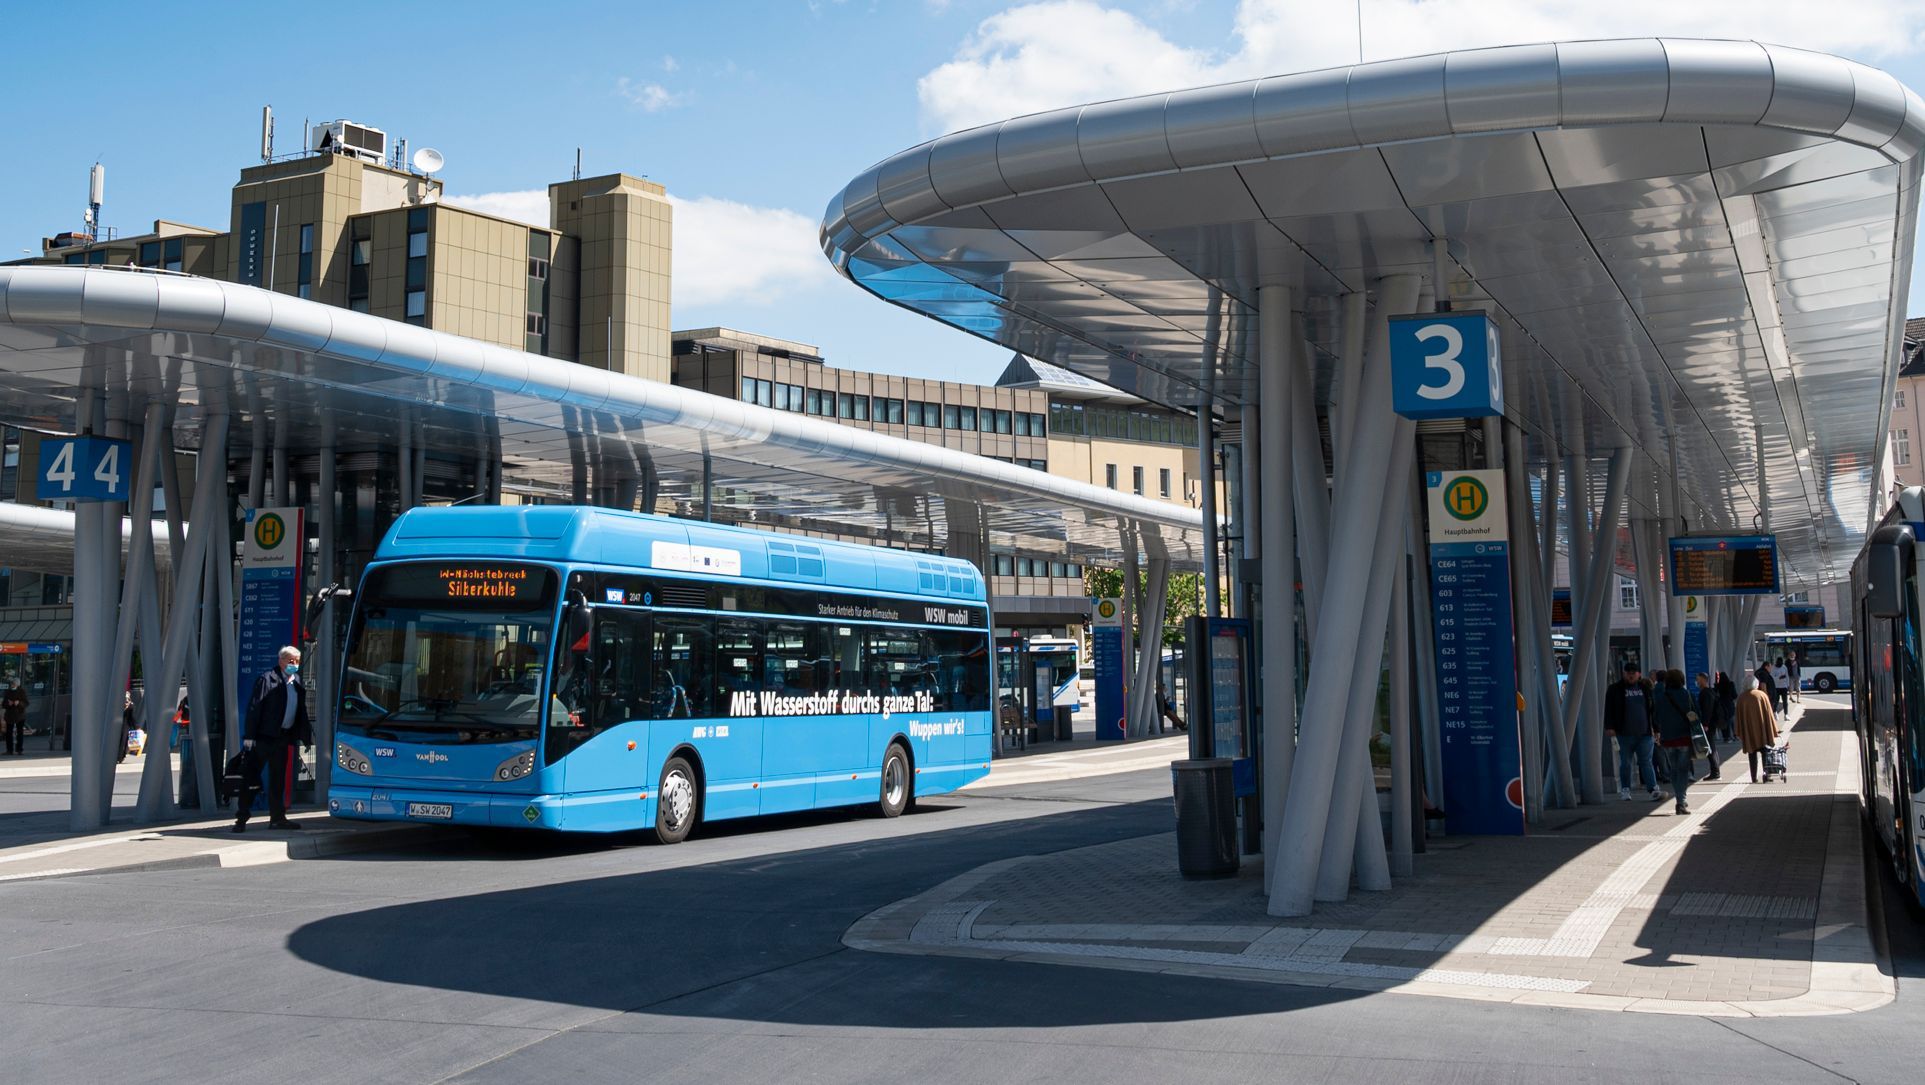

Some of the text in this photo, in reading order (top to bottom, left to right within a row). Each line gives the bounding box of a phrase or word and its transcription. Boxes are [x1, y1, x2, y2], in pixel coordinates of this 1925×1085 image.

[248, 229, 256, 278] EXPRESS
[1414, 324, 1466, 400] 3
[1489, 327, 1499, 401] 3
[46, 442, 76, 492] 4
[94, 444, 120, 493] 4
[1444, 528, 1490, 536] Hauptbahnhof
[1438, 560, 1456, 568] CE64
[448, 580, 516, 596] Silberkuhle
[606, 590, 623, 602] WSW
[818, 603, 836, 615] Starker
[836, 605, 854, 617] Antrieb
[863, 607, 872, 618] den
[872, 608, 899, 620] Klimaschutz
[924, 607, 969, 625] WSW mobil
[1442, 647, 1456, 655] 625
[1443, 677, 1458, 685] 645
[730, 689, 934, 720] Mit Wasserstoff durchs ganze Tal:
[909, 718, 965, 742] Wuppen wir's!
[1446, 735, 1451, 744] E
[376, 748, 394, 757] WSW
[432, 806, 451, 816] 2047
